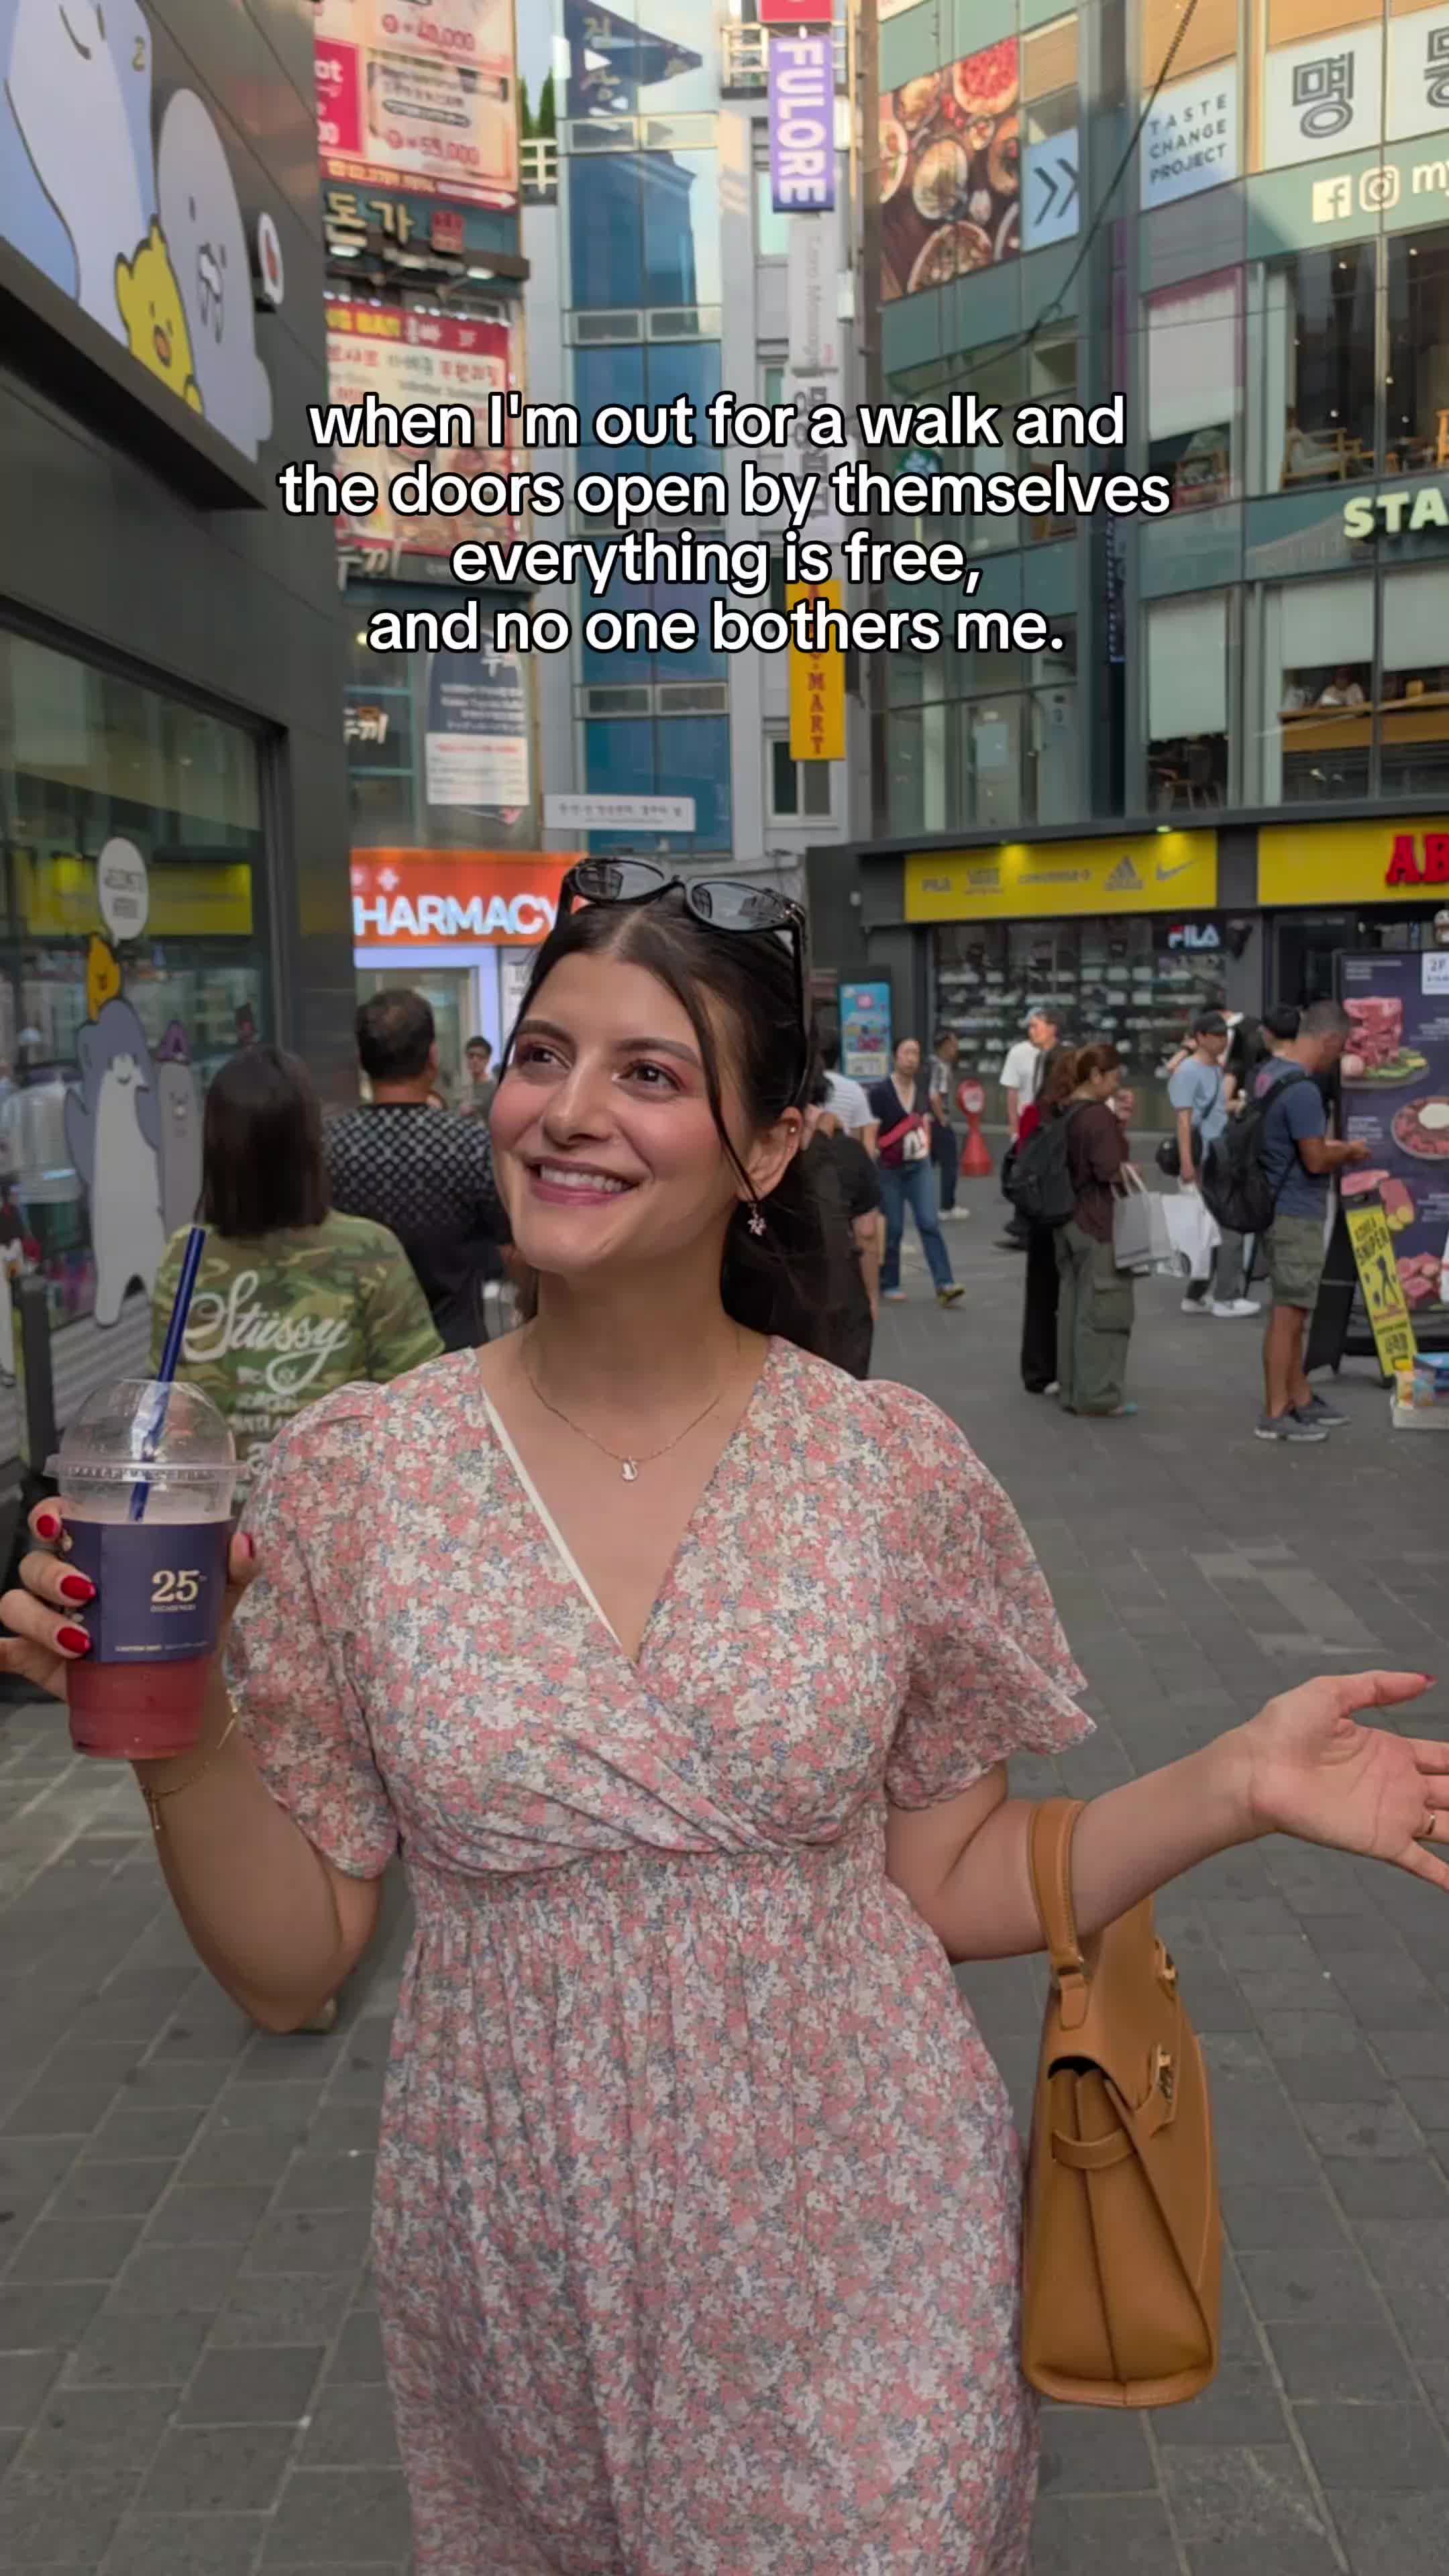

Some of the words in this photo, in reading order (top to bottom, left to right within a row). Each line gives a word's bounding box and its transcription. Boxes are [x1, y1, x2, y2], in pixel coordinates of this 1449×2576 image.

[775, 40, 828, 204] FULORE
[1148, 93, 1227, 135] TASTE
[1148, 118, 1227, 160] CHANGE
[1148, 142, 1227, 184] PROJECT
[1344, 488, 1449, 538] STA
[1168, 922, 1220, 949] FILA
[151, 1570, 199, 1603] 25
